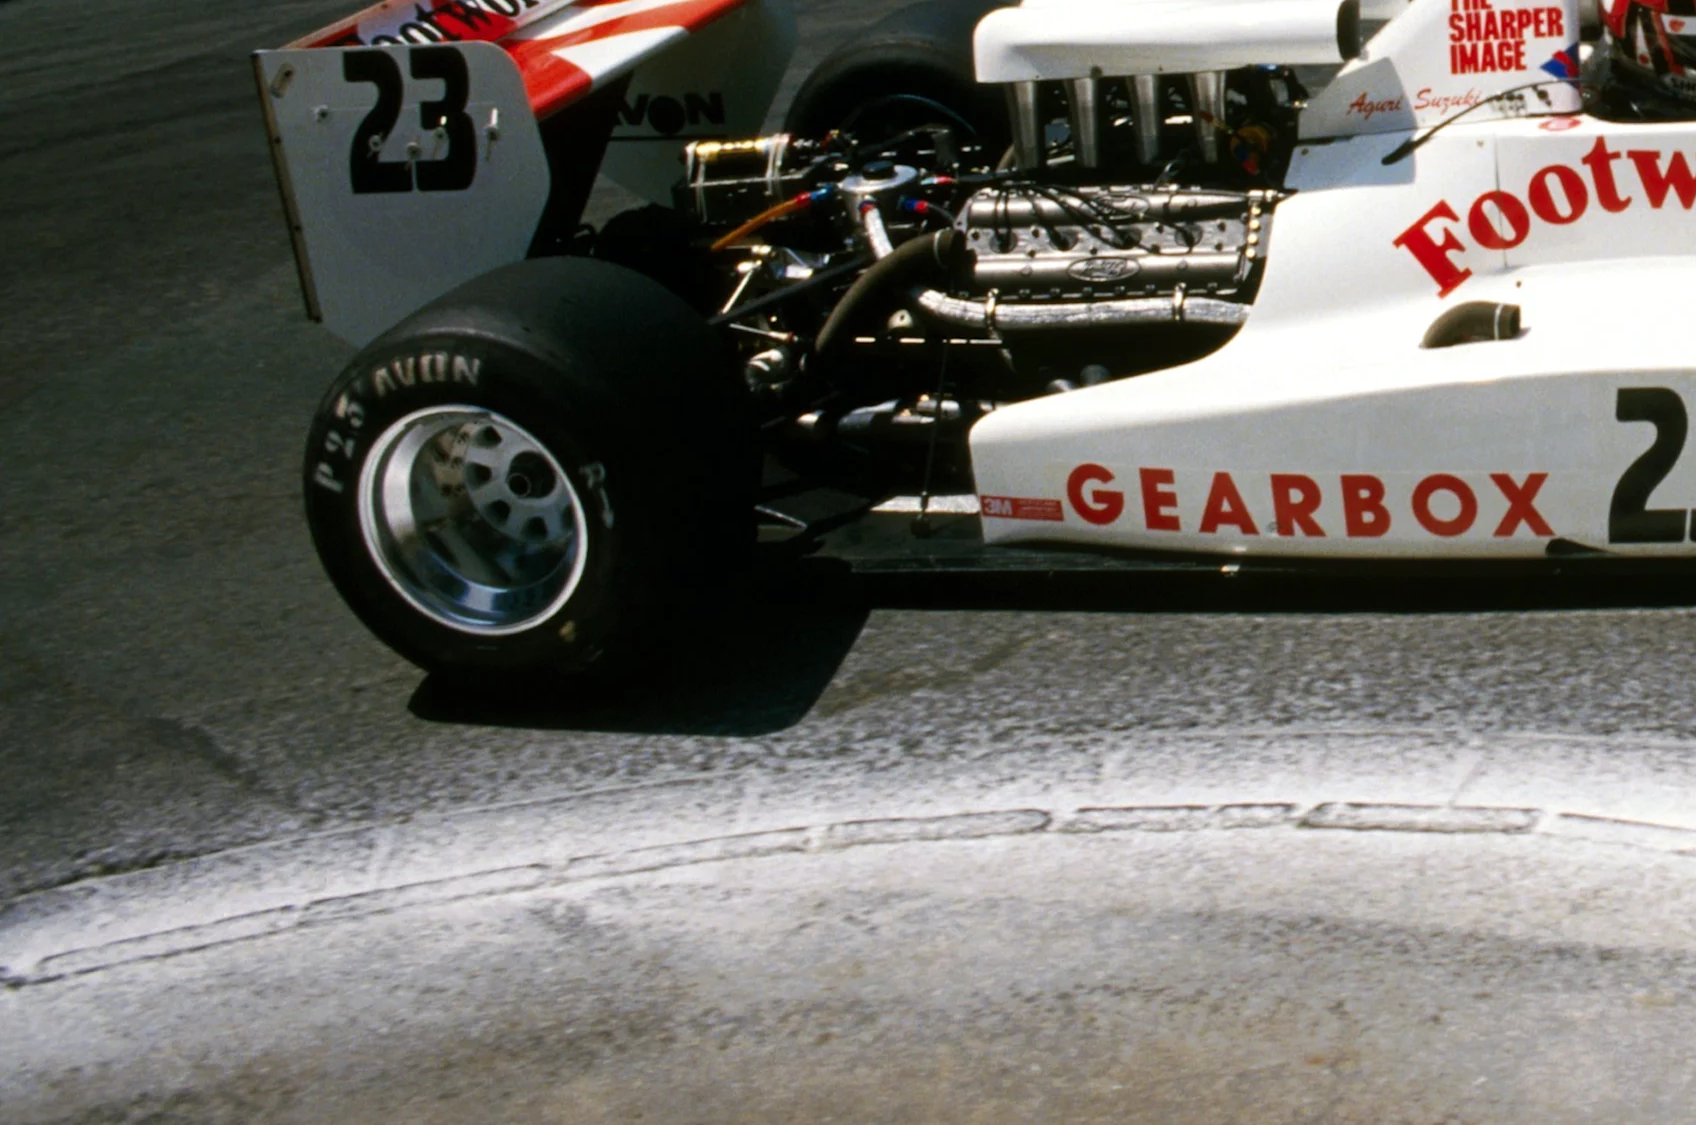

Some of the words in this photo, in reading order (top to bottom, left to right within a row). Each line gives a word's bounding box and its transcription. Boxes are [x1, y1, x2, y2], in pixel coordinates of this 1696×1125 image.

[1448, 7, 1564, 43] SHARPER
[1450, 40, 1528, 76] IMAGE
[342, 45, 476, 194] 23
[612, 92, 726, 134] VON
[1346, 92, 1402, 120] Aguri
[1413, 87, 1482, 116] Suzuki
[371, 350, 482, 398] AVON
[1066, 463, 1557, 538] GEARBOX
